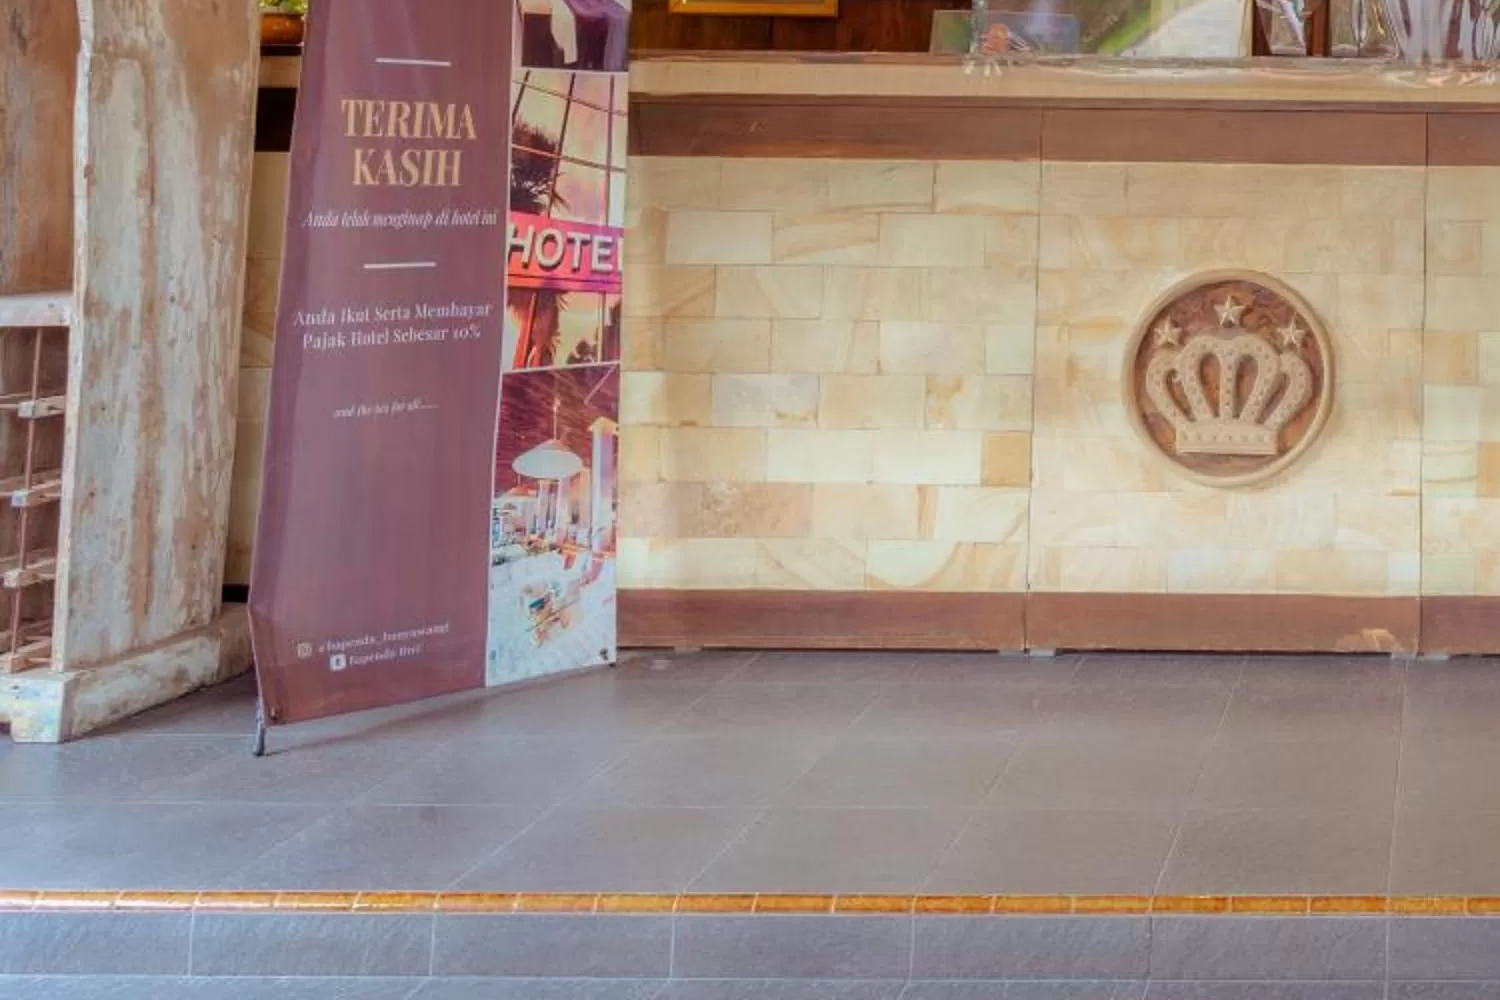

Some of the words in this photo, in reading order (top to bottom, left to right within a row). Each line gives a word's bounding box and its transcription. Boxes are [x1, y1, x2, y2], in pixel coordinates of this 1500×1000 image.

[341, 99, 478, 140] TERIMA
[352, 149, 463, 188] KASIH
[293, 308, 335, 327] Anda
[340, 306, 370, 324] Ikut
[375, 304, 411, 321] Serta
[414, 301, 493, 322] Membayar
[302, 331, 347, 351] Pajak
[351, 328, 389, 346] Hotel
[393, 326, 449, 343] Sebesar
[453, 323, 482, 340] 10%
